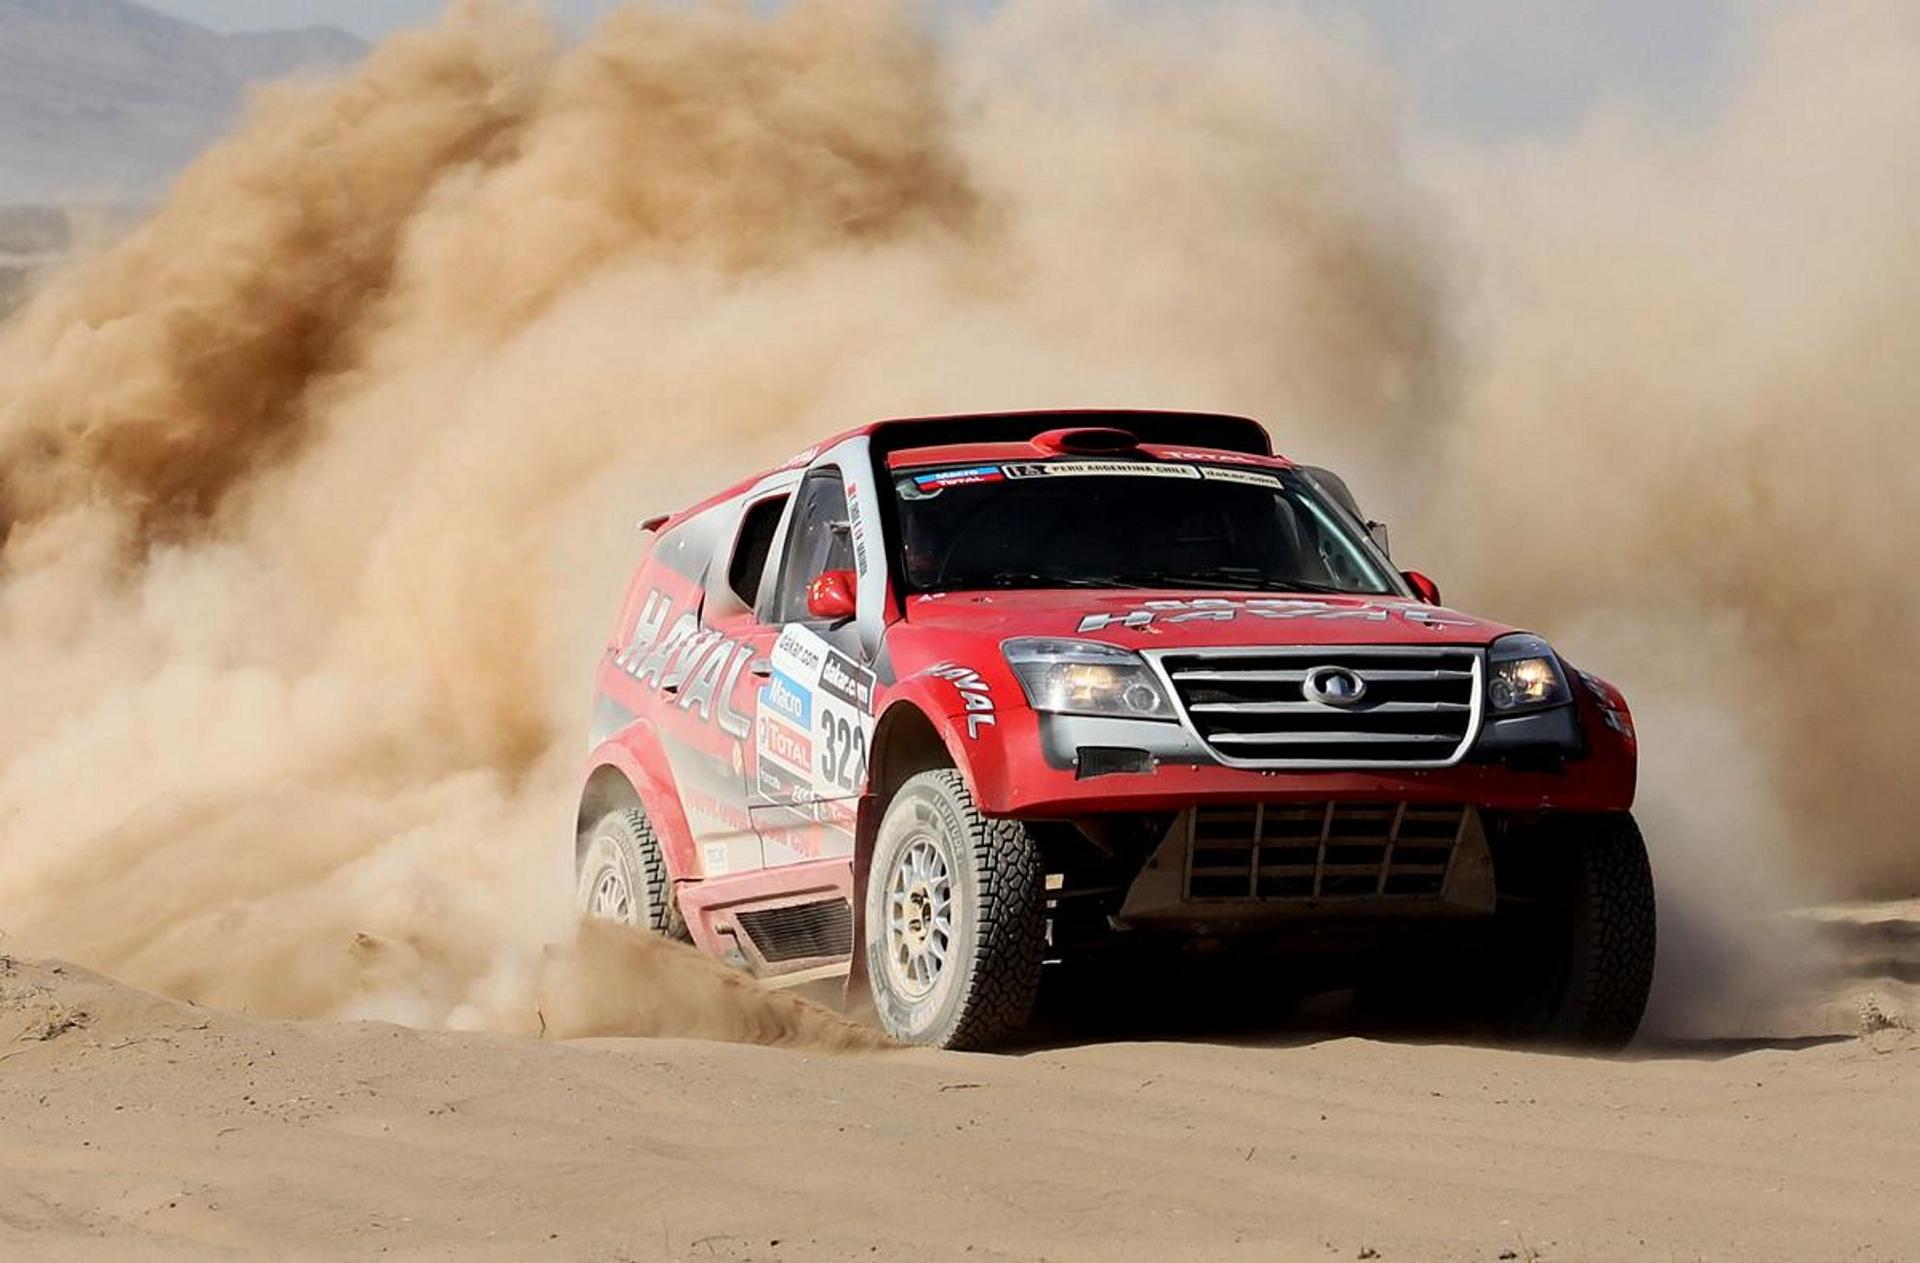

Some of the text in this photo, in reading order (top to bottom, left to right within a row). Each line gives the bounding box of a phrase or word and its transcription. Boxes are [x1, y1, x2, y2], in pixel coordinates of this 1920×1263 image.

[1051, 463, 1189, 475] PERU ARGENTINA CHILE
[1206, 469, 1279, 486] dakar.com
[614, 588, 754, 741] HAVAL
[779, 632, 819, 668] dakar.com
[767, 677, 804, 717] Macro
[823, 658, 869, 704] dakar.com
[768, 725, 811, 772] TOTAL
[821, 709, 868, 796] 322
